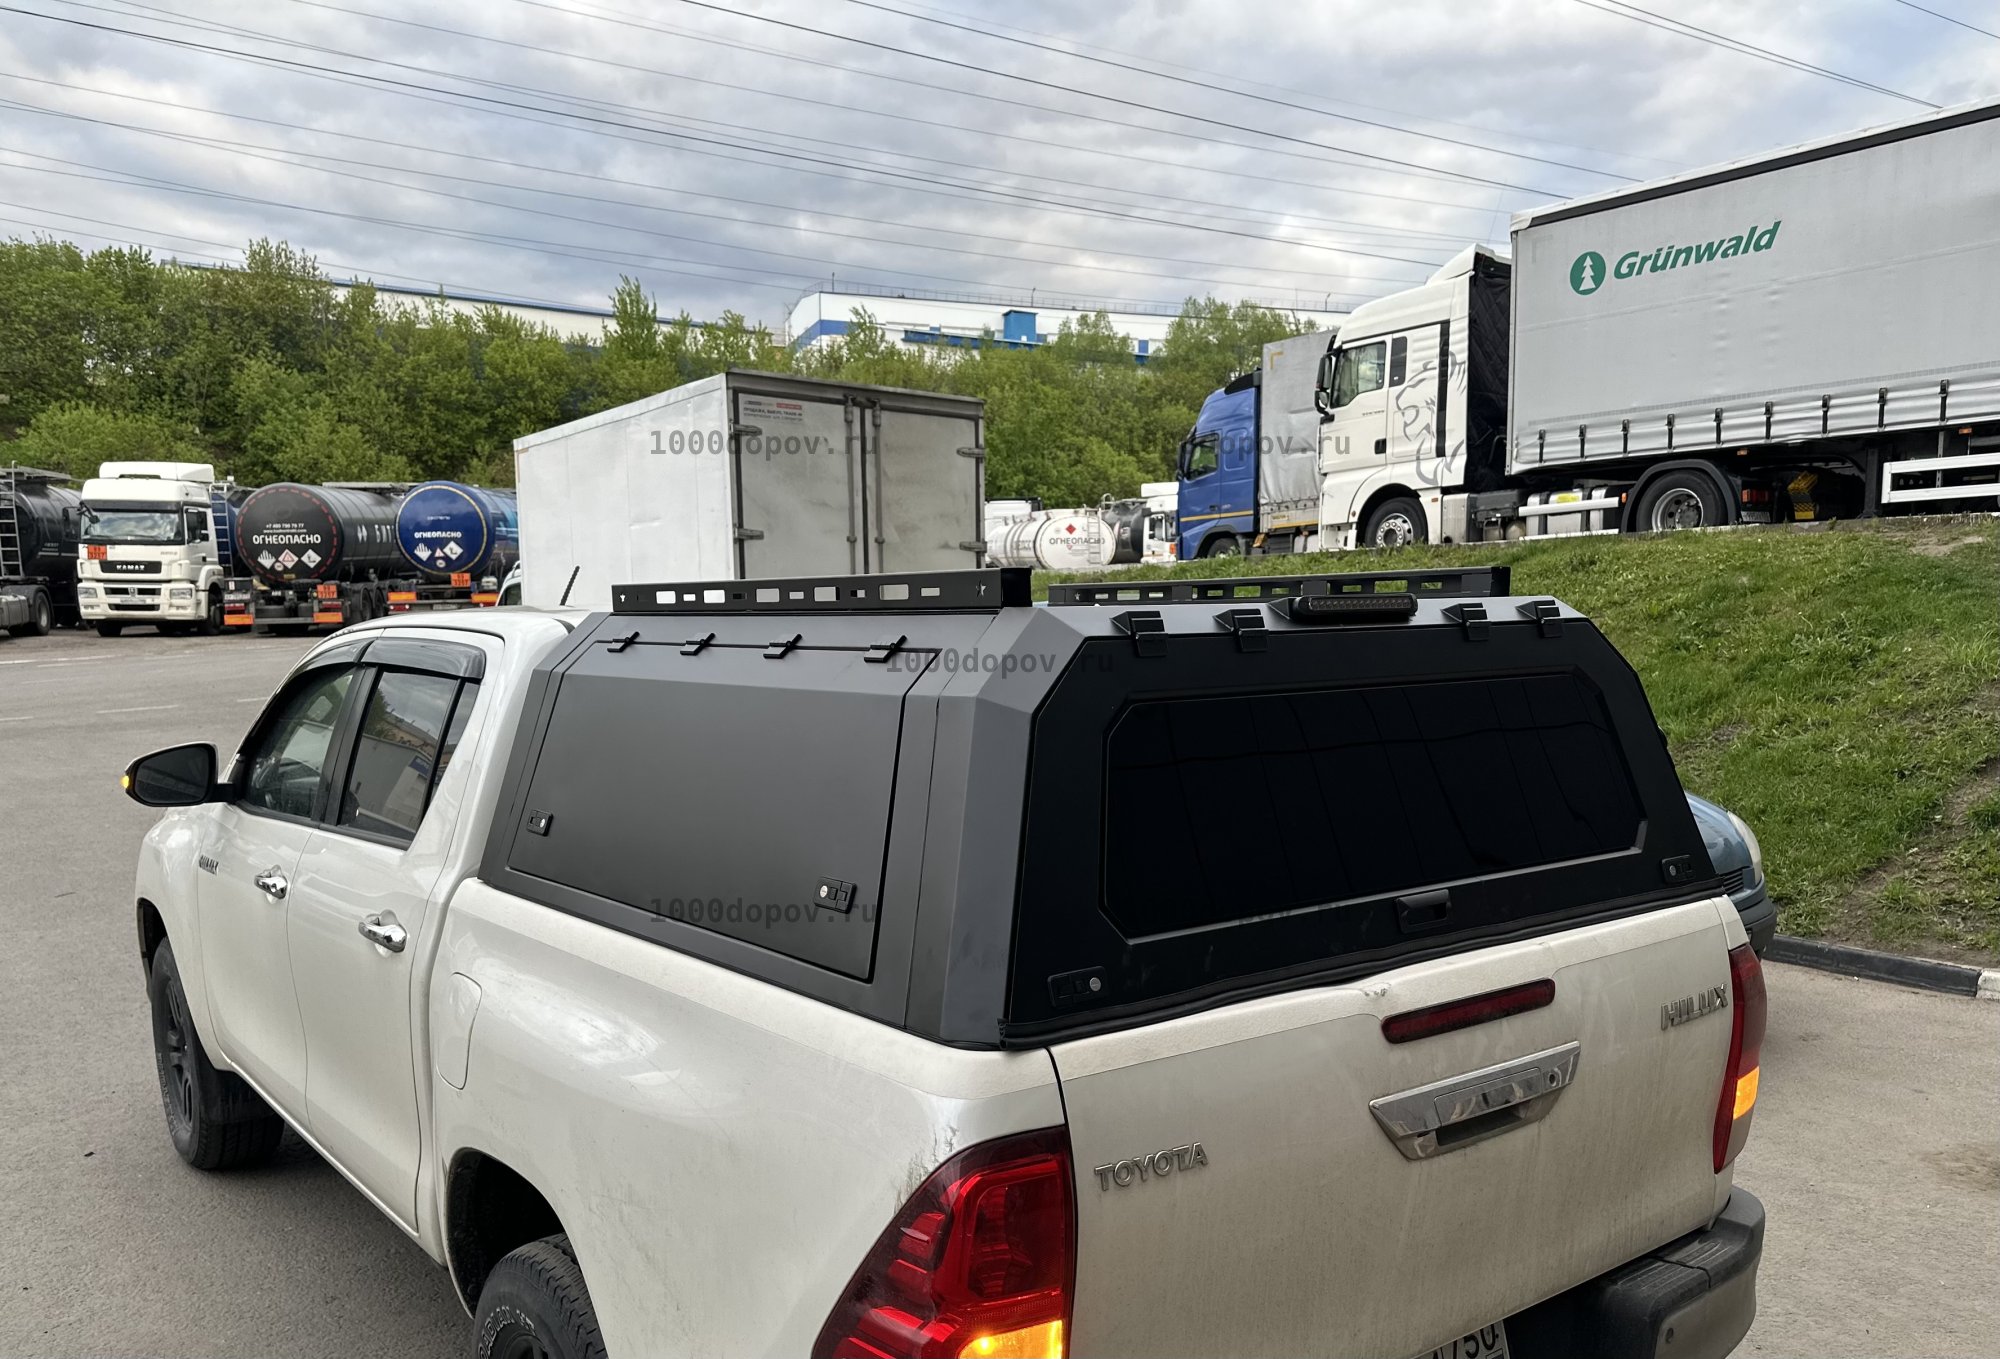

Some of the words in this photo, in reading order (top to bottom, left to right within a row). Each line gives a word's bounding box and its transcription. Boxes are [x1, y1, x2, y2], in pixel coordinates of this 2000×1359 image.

[1613, 220, 1782, 280] Grünwald
[252, 533, 322, 545] ОГНЕОПАСНО
[414, 531, 462, 539] ОГНЕОПАСНО
[1660, 983, 1729, 1031] HILUX
[1093, 1141, 1209, 1192] TOYOTA
